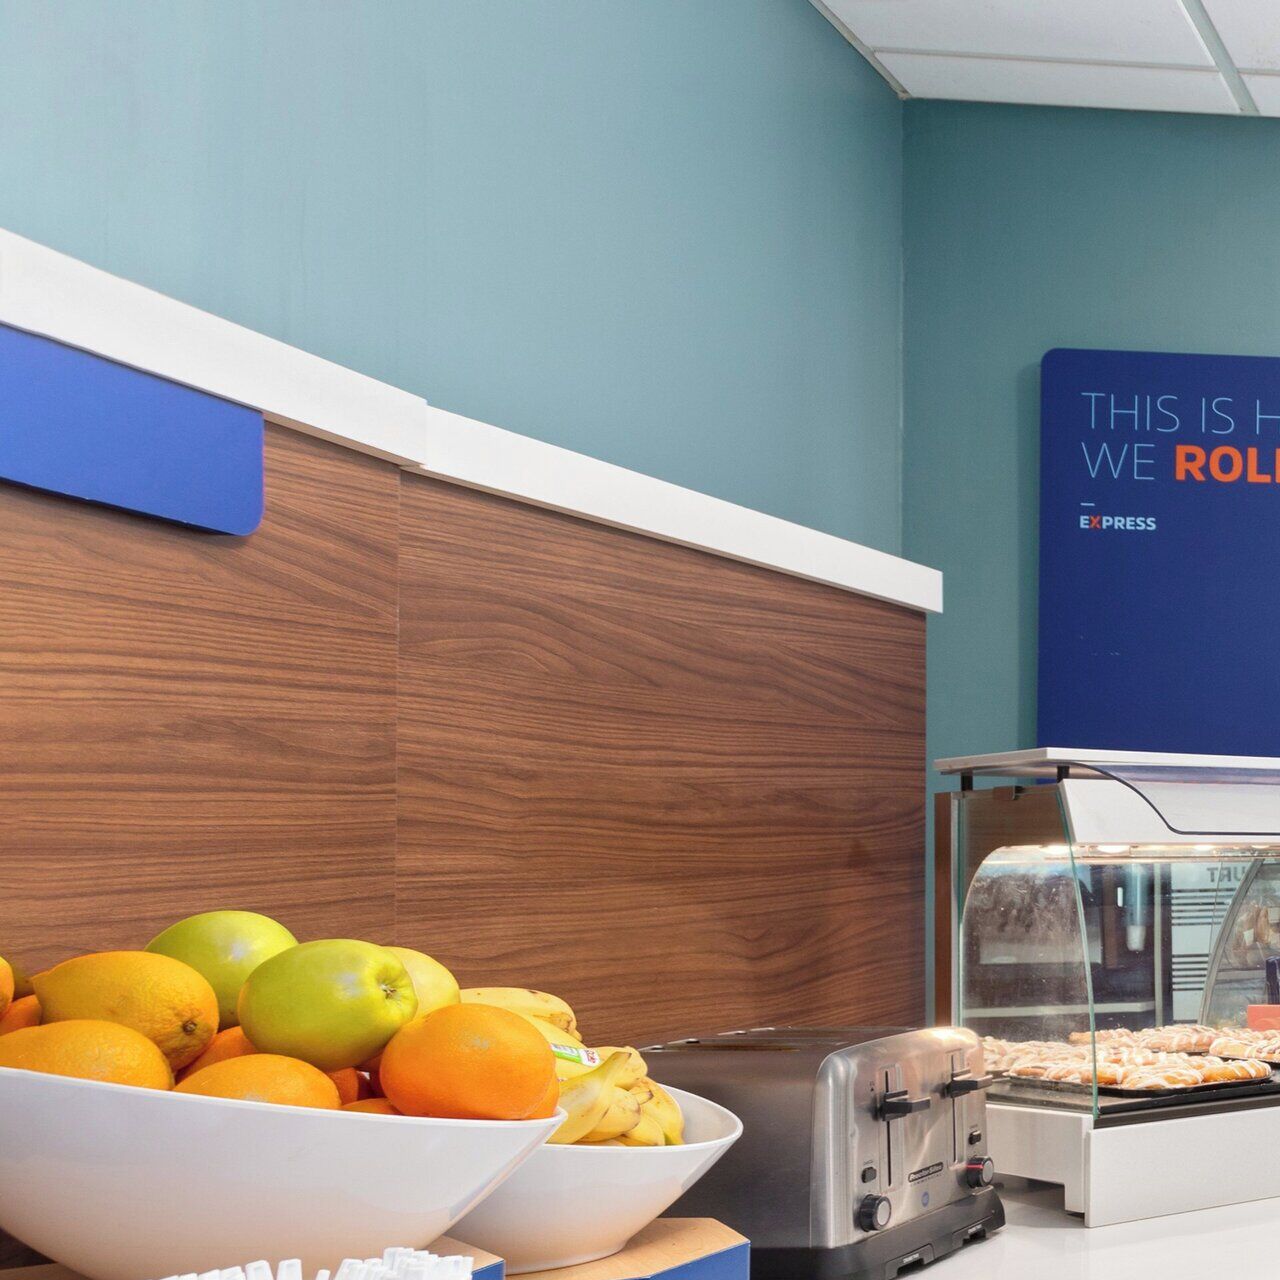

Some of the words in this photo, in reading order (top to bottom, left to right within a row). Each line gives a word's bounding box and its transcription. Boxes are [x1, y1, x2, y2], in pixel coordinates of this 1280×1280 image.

[1081, 391, 1180, 433] THIS
[1202, 397, 1235, 435] IS
[1081, 441, 1156, 480] WE
[1079, 515, 1157, 531] EXPRESS
